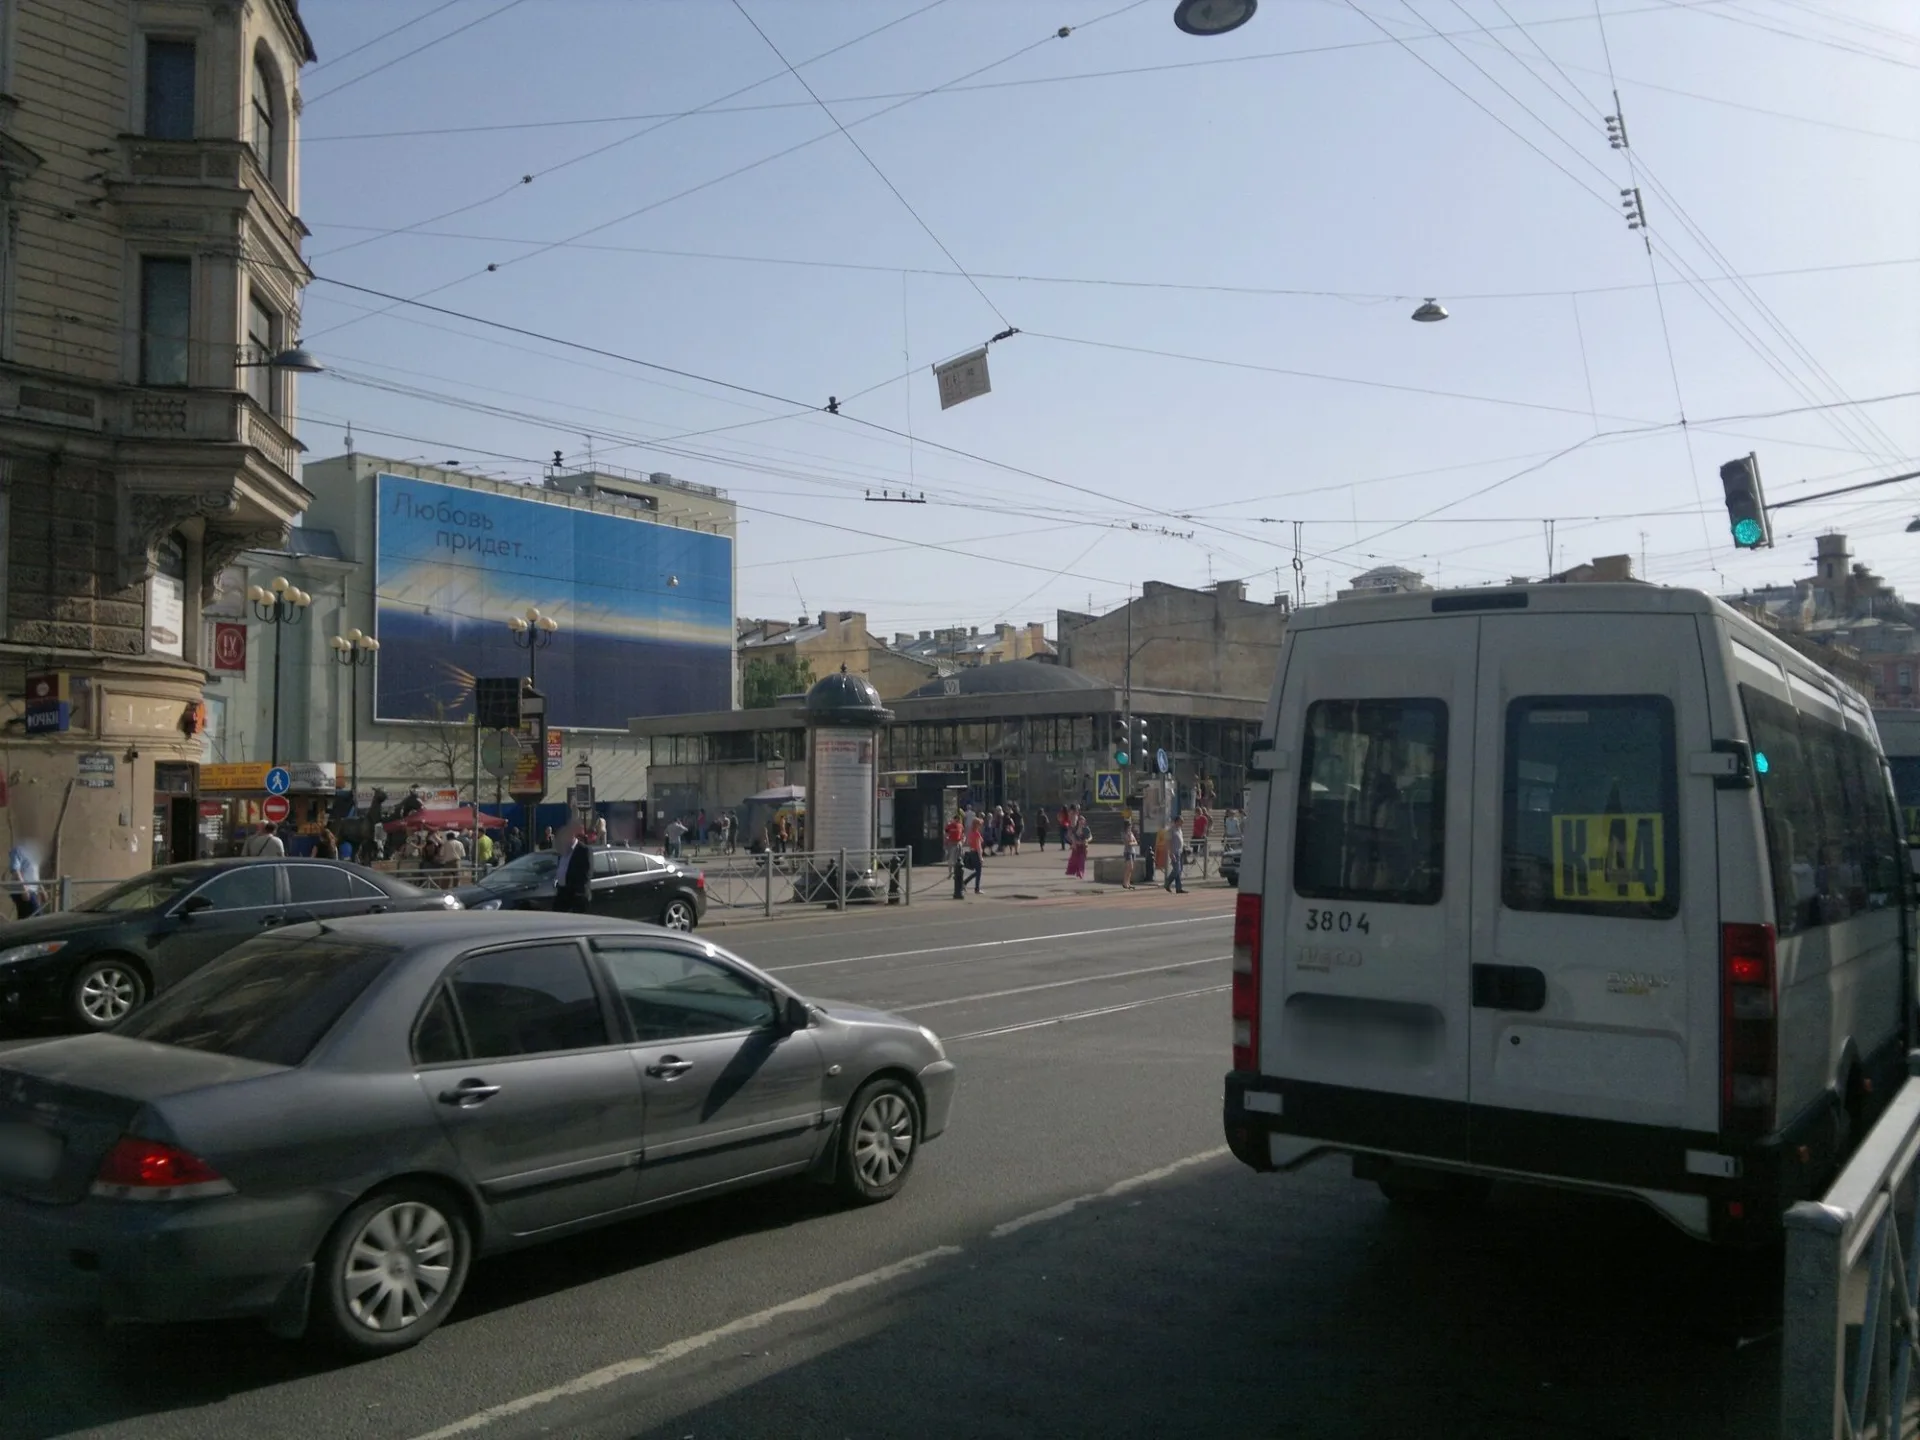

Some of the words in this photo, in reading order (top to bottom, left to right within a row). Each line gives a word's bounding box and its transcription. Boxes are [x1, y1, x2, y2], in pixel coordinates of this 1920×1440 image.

[393, 492, 494, 531] Любовь
[436, 529, 539, 561] придет...
[1306, 908, 1371, 935] 3804
